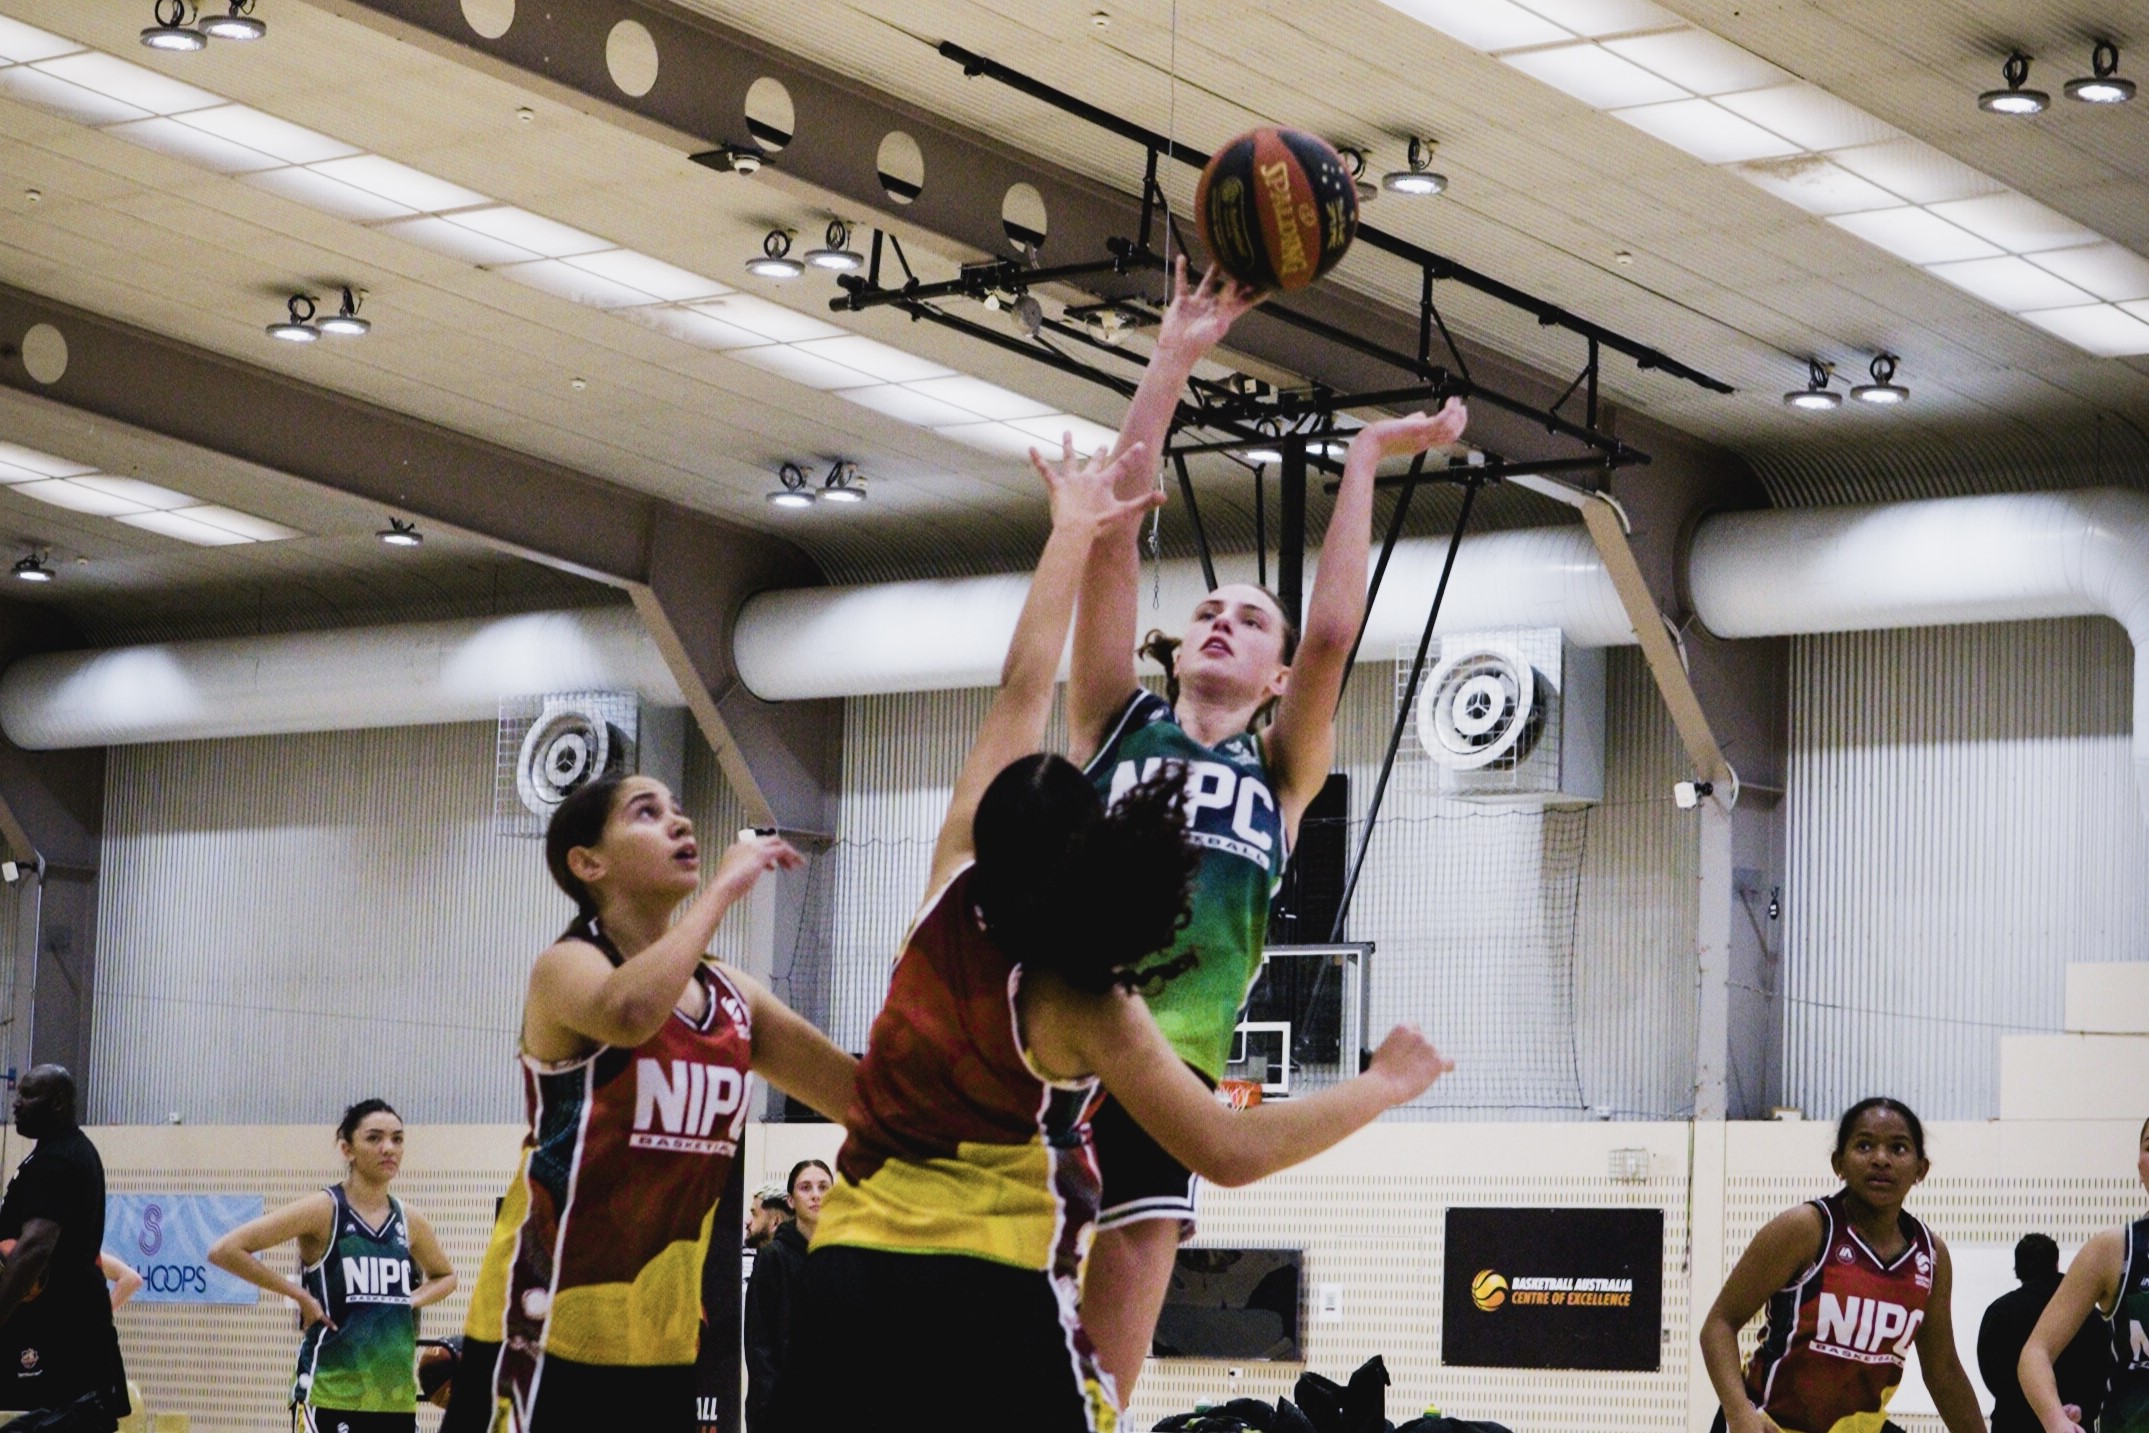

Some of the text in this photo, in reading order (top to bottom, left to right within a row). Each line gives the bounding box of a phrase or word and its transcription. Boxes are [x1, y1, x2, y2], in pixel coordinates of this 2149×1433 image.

[1104, 757, 1274, 851] NPC
[1512, 1277, 1633, 1292] BASKETBALL AUSTRALIA
[1511, 1291, 1632, 1307] CENTRE OF EXCELLENCE
